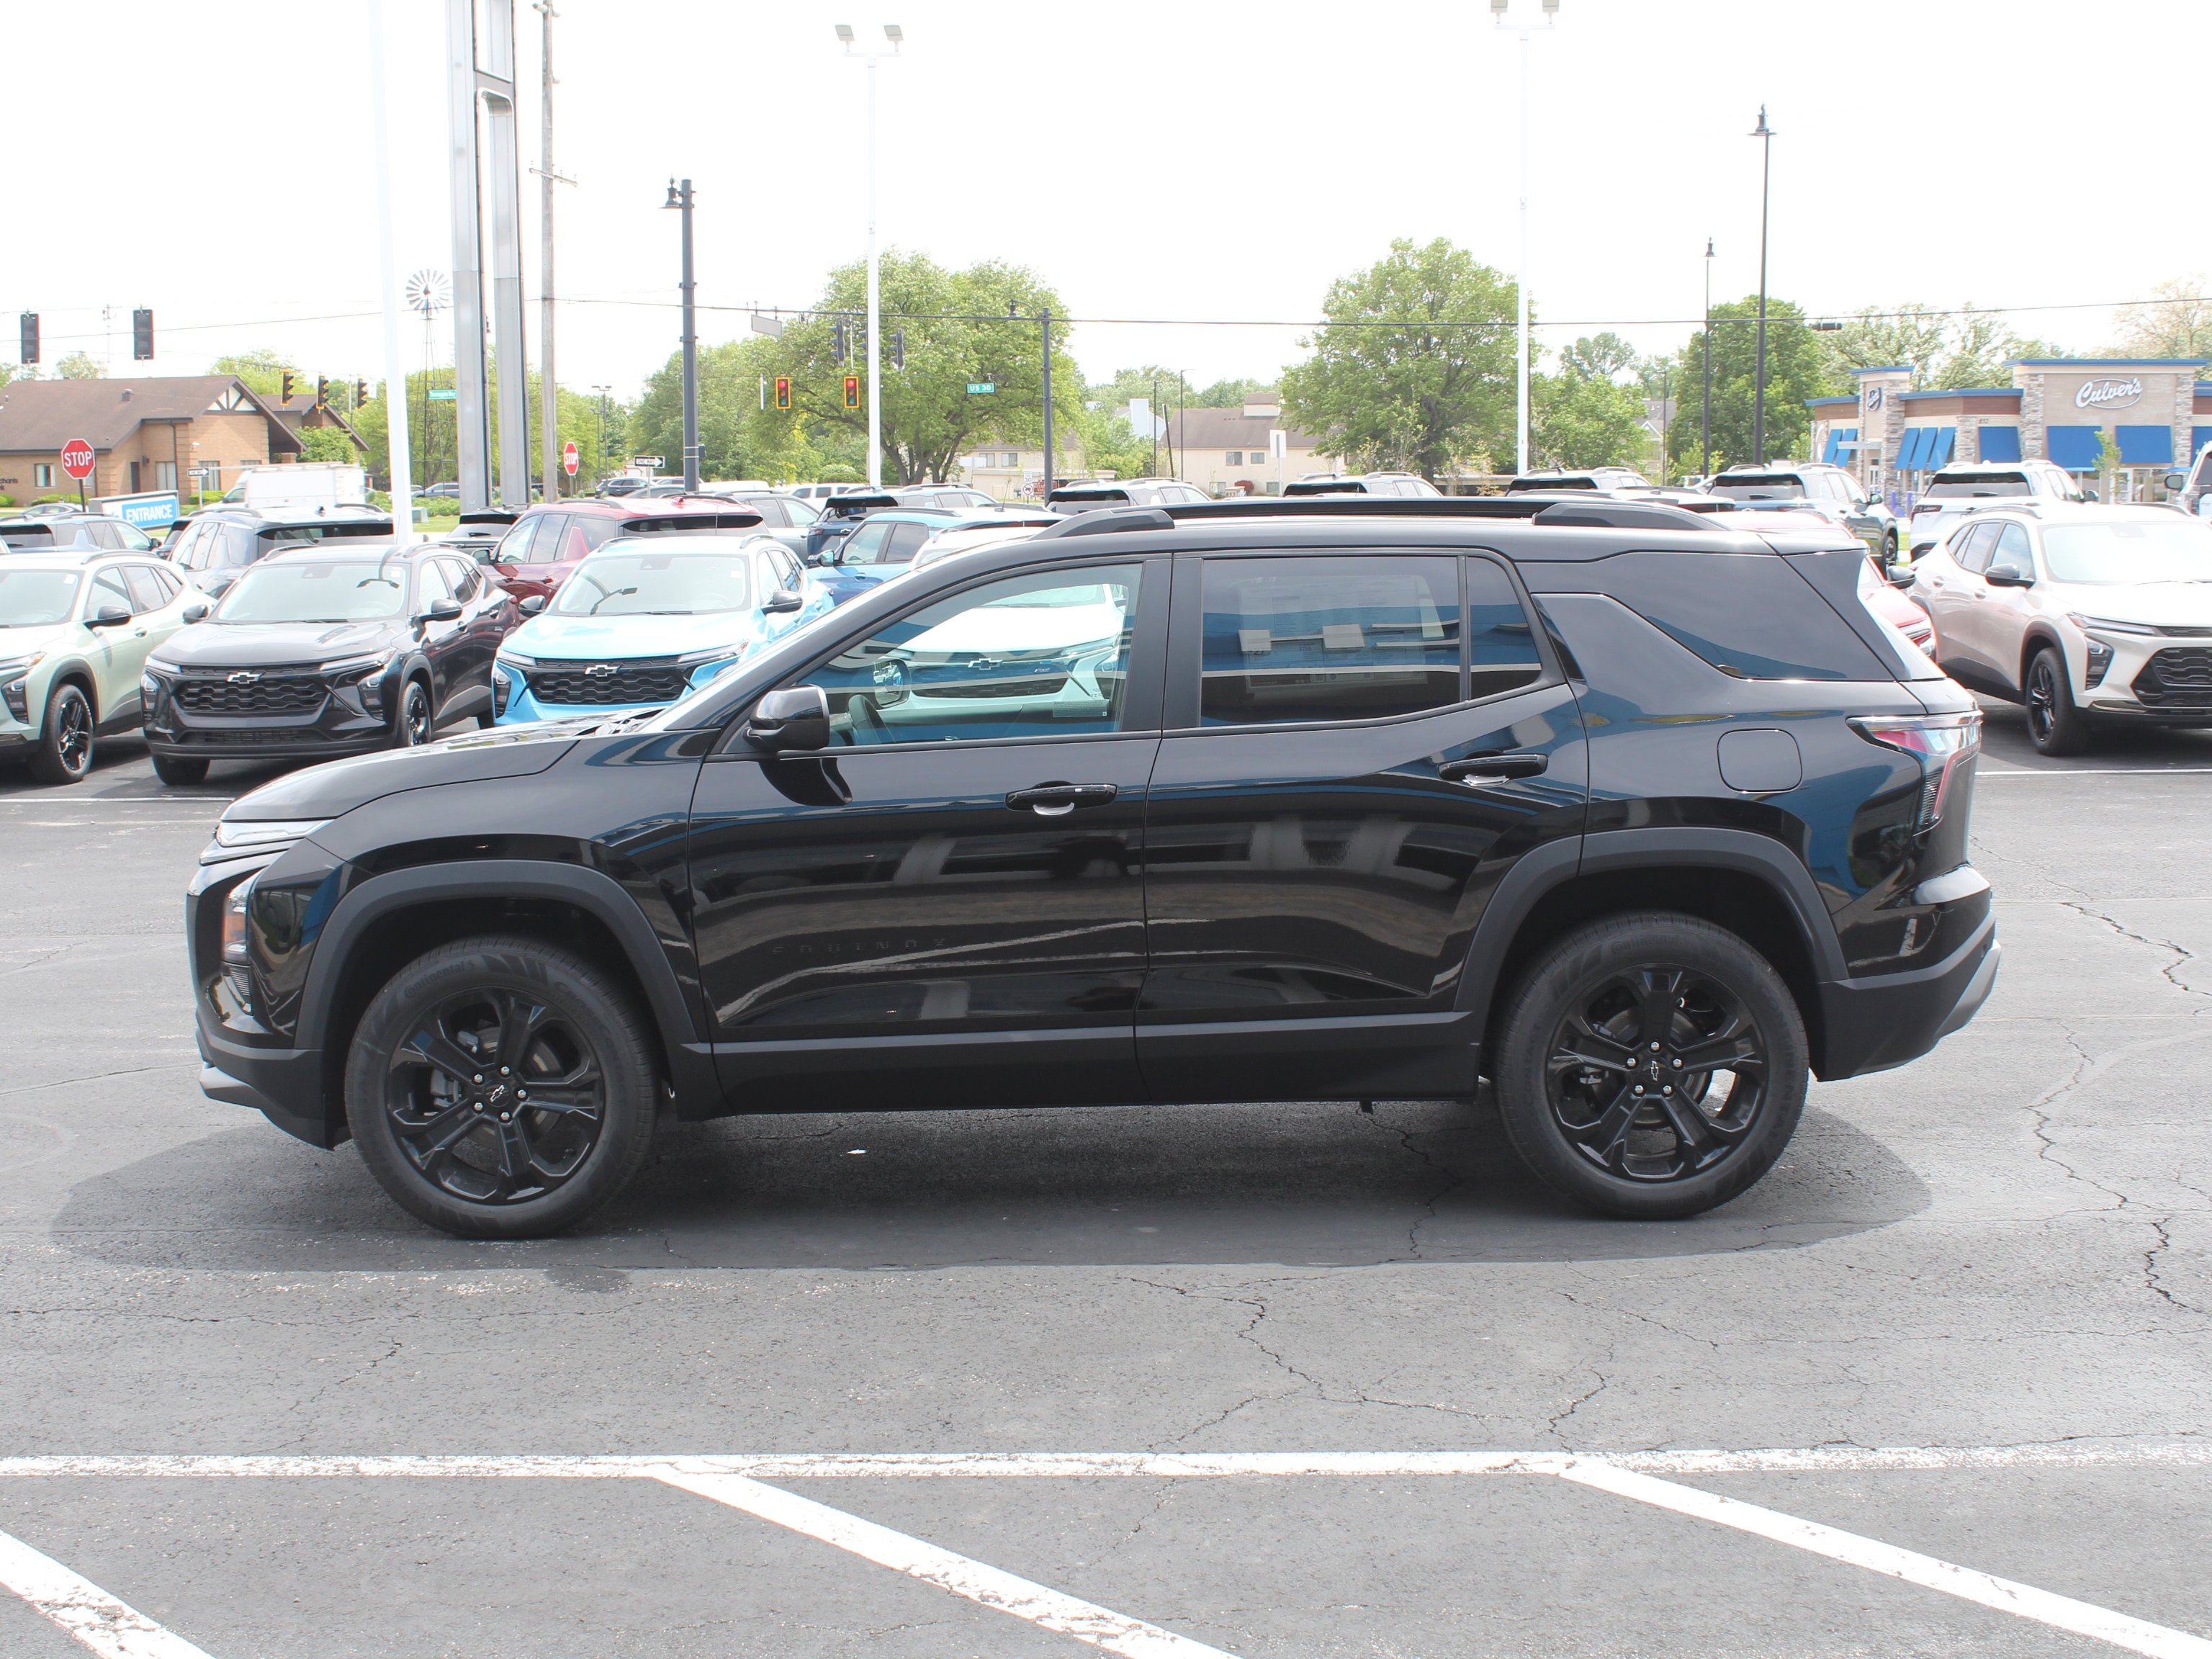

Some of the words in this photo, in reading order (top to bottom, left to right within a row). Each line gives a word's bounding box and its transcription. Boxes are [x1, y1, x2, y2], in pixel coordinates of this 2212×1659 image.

[2075, 377, 2143, 408] Culver's
[64, 451, 92, 467] STOP
[565, 453, 577, 465] STOP
[125, 505, 174, 523] ENTRANCE
[403, 961, 465, 999] Continental
